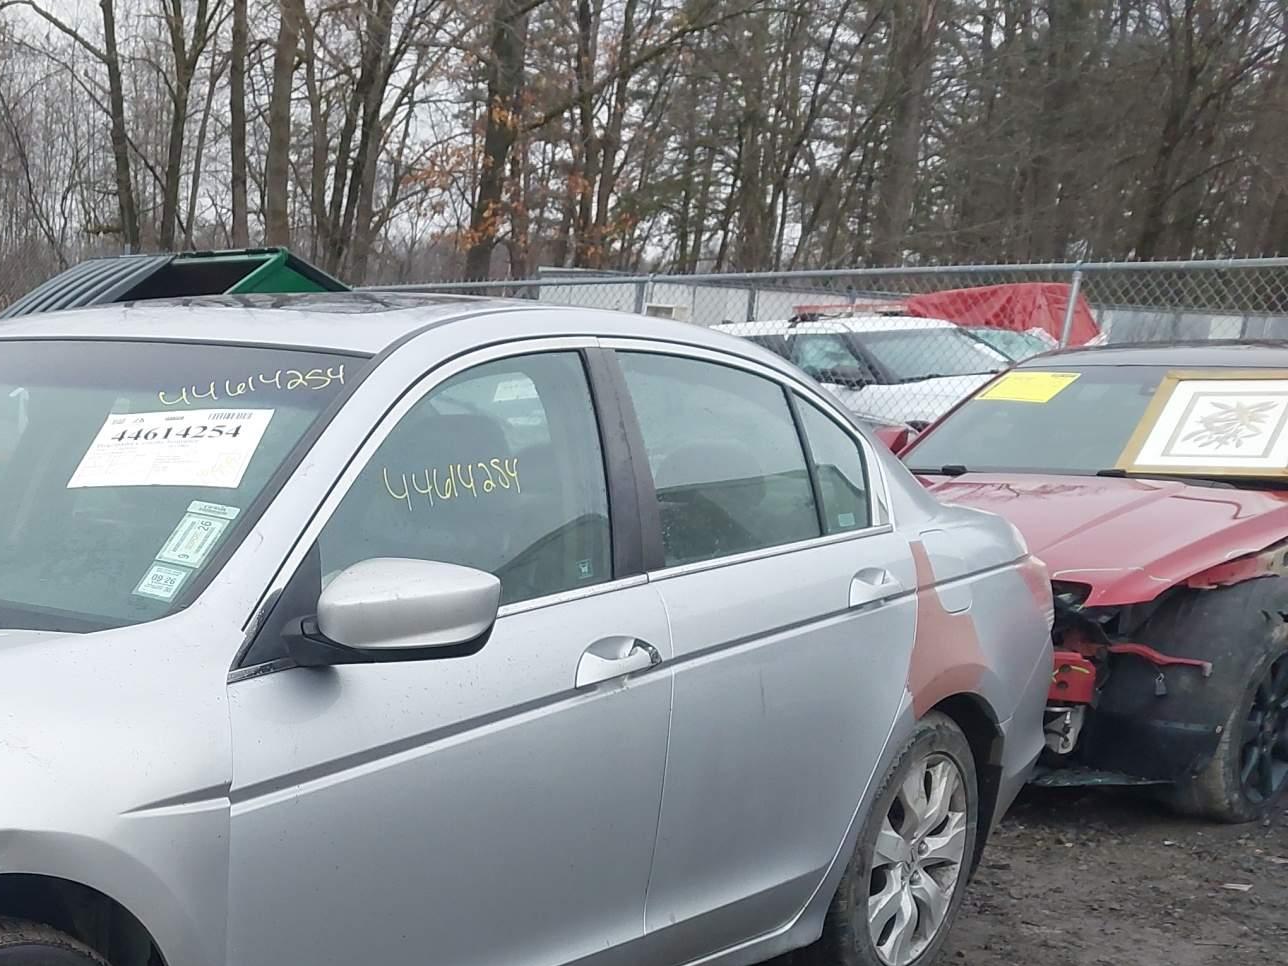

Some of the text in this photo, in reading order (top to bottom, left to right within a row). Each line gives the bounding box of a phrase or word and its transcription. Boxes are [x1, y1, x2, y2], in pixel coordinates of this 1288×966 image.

[159, 365, 345, 405] 44614254
[111, 424, 243, 442] 44614254
[383, 458, 521, 512] 44614254
